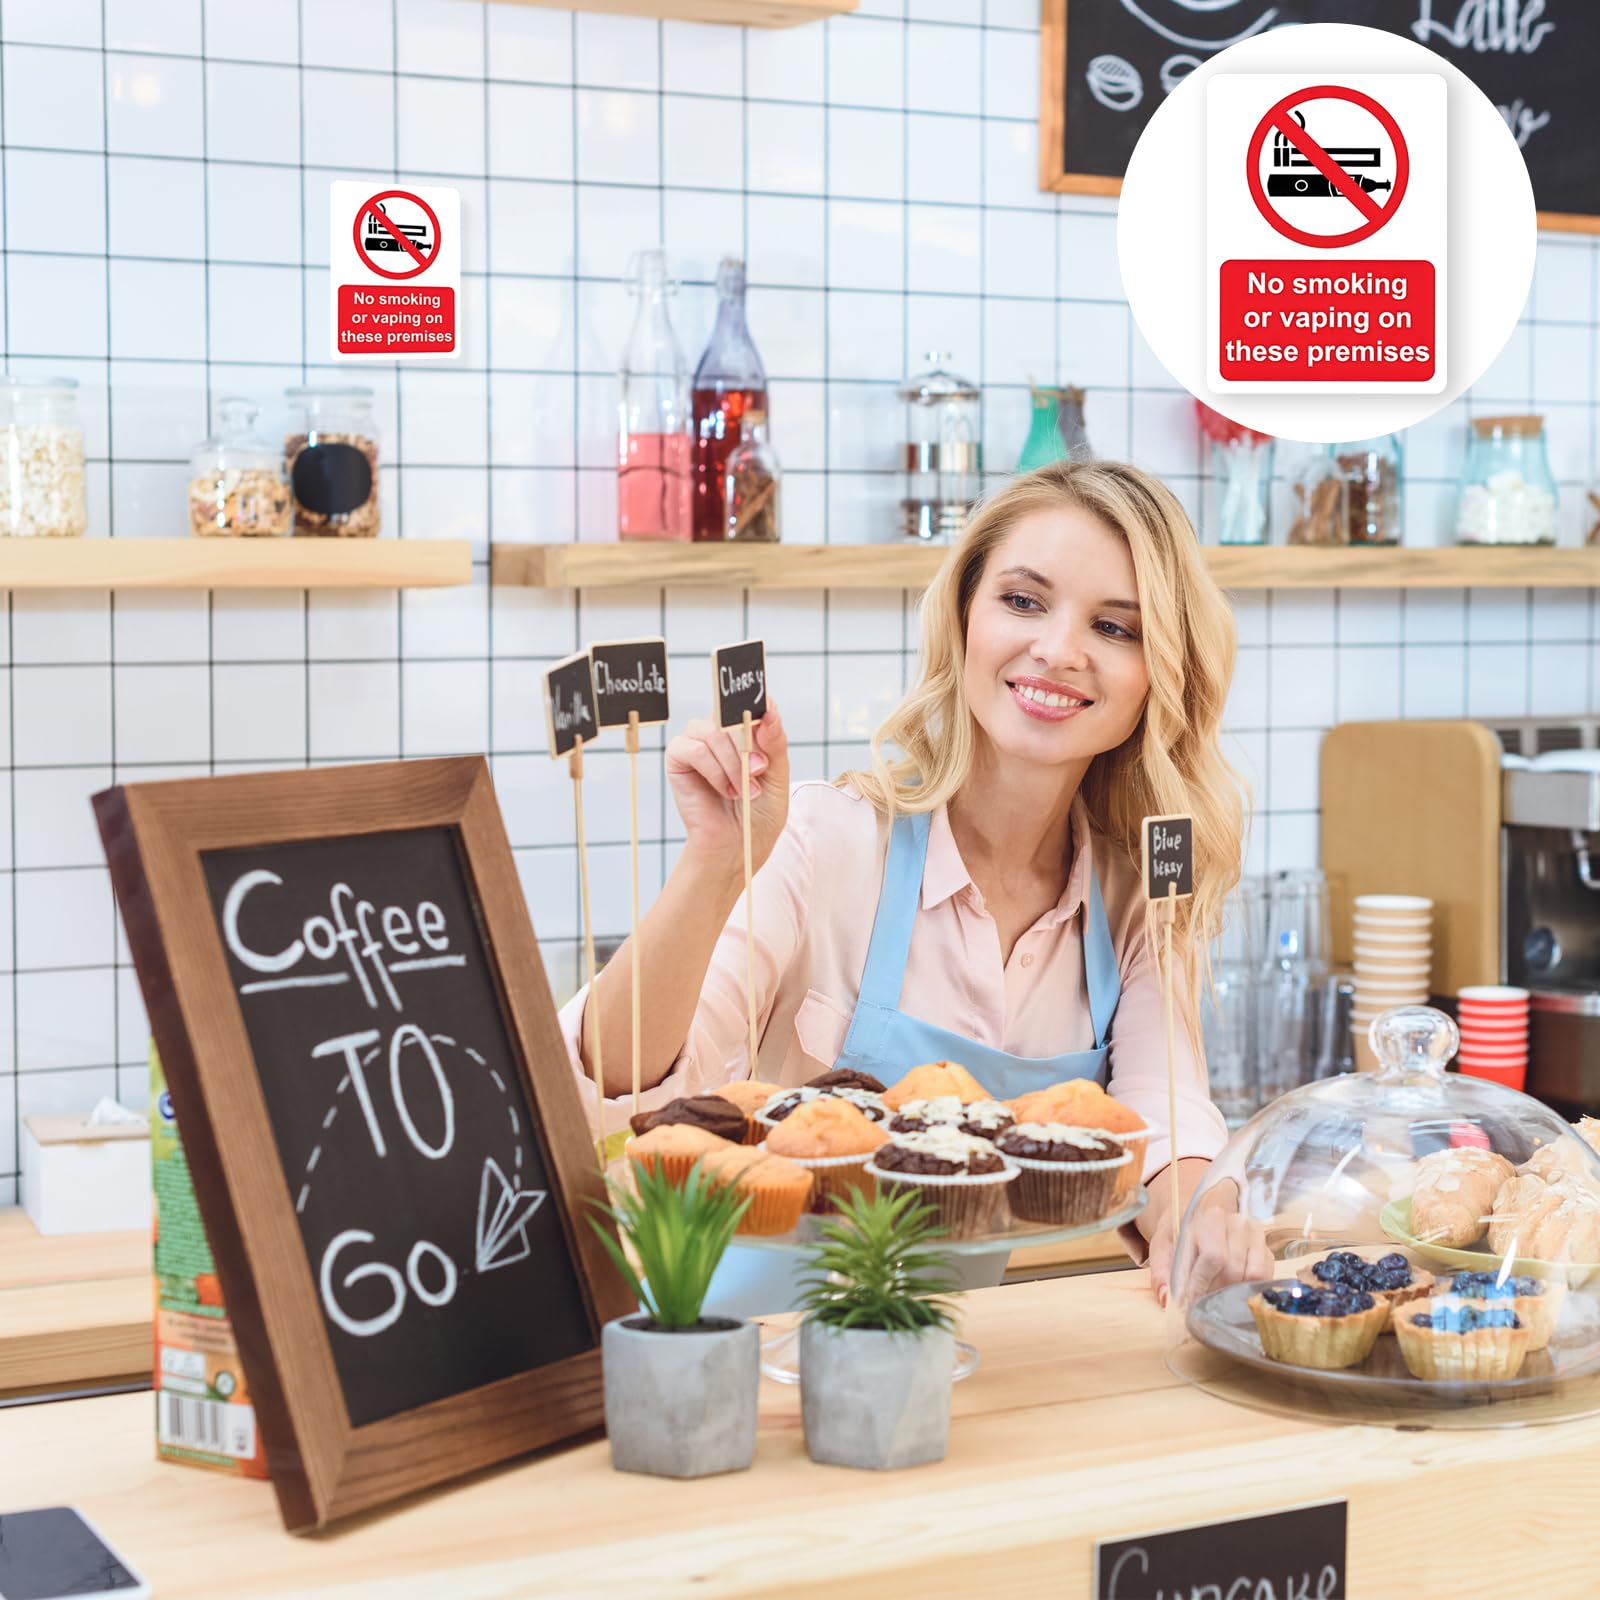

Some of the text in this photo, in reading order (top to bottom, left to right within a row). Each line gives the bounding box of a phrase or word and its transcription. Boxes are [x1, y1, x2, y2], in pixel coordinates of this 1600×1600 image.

[353, 291, 441, 309] No smoking
[351, 311, 443, 327] or vaping on
[341, 329, 453, 346] these premises
[593, 660, 665, 694] Chocolate
[1153, 825, 1182, 855] Blue
[223, 869, 447, 1011] Coffee
[311, 1024, 455, 1159] TO
[320, 1229, 458, 1337] Go
